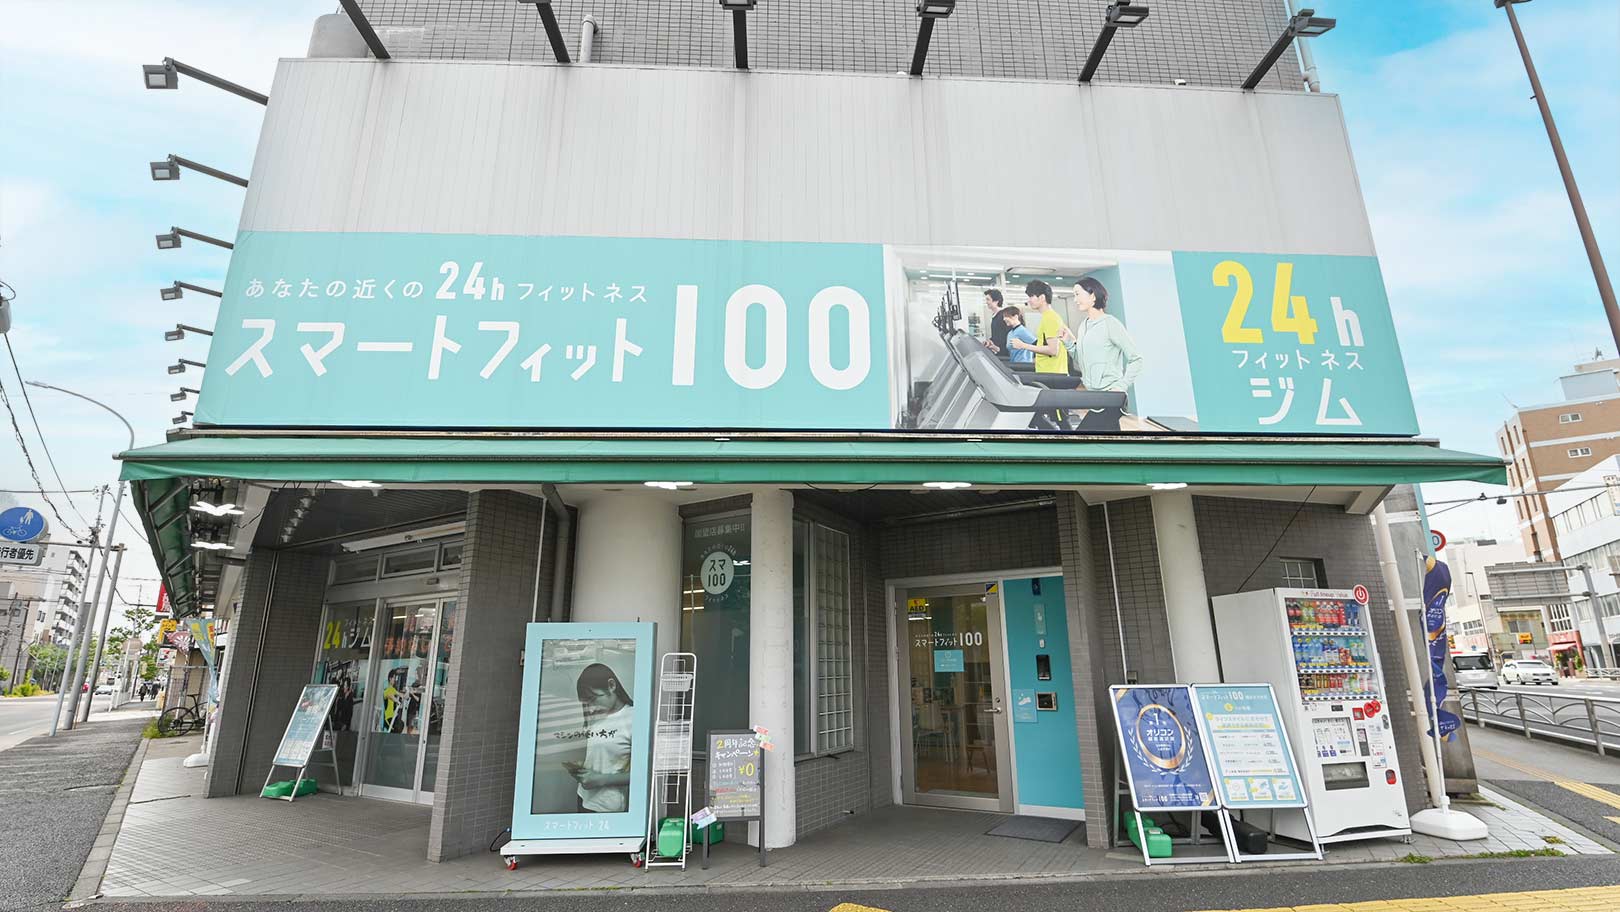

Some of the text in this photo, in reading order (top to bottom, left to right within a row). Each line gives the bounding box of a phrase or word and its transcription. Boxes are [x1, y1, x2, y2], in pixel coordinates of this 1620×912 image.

[246, 261, 648, 303] あなたの近くの 24h フィットネス
[1212, 260, 1365, 347] 24h
[225, 284, 871, 390] スマートフィット 100
[1232, 349, 1364, 370] フィットネス
[1250, 377, 1363, 425] ジム
[0, 546, 35, 560] 行者優先
[709, 559, 726, 572] スマ
[708, 573, 726, 587] 100
[915, 632, 982, 647] スマートフィット 100
[1146, 729, 1174, 737] オリコン
[715, 749, 754, 760] キャンペーン
